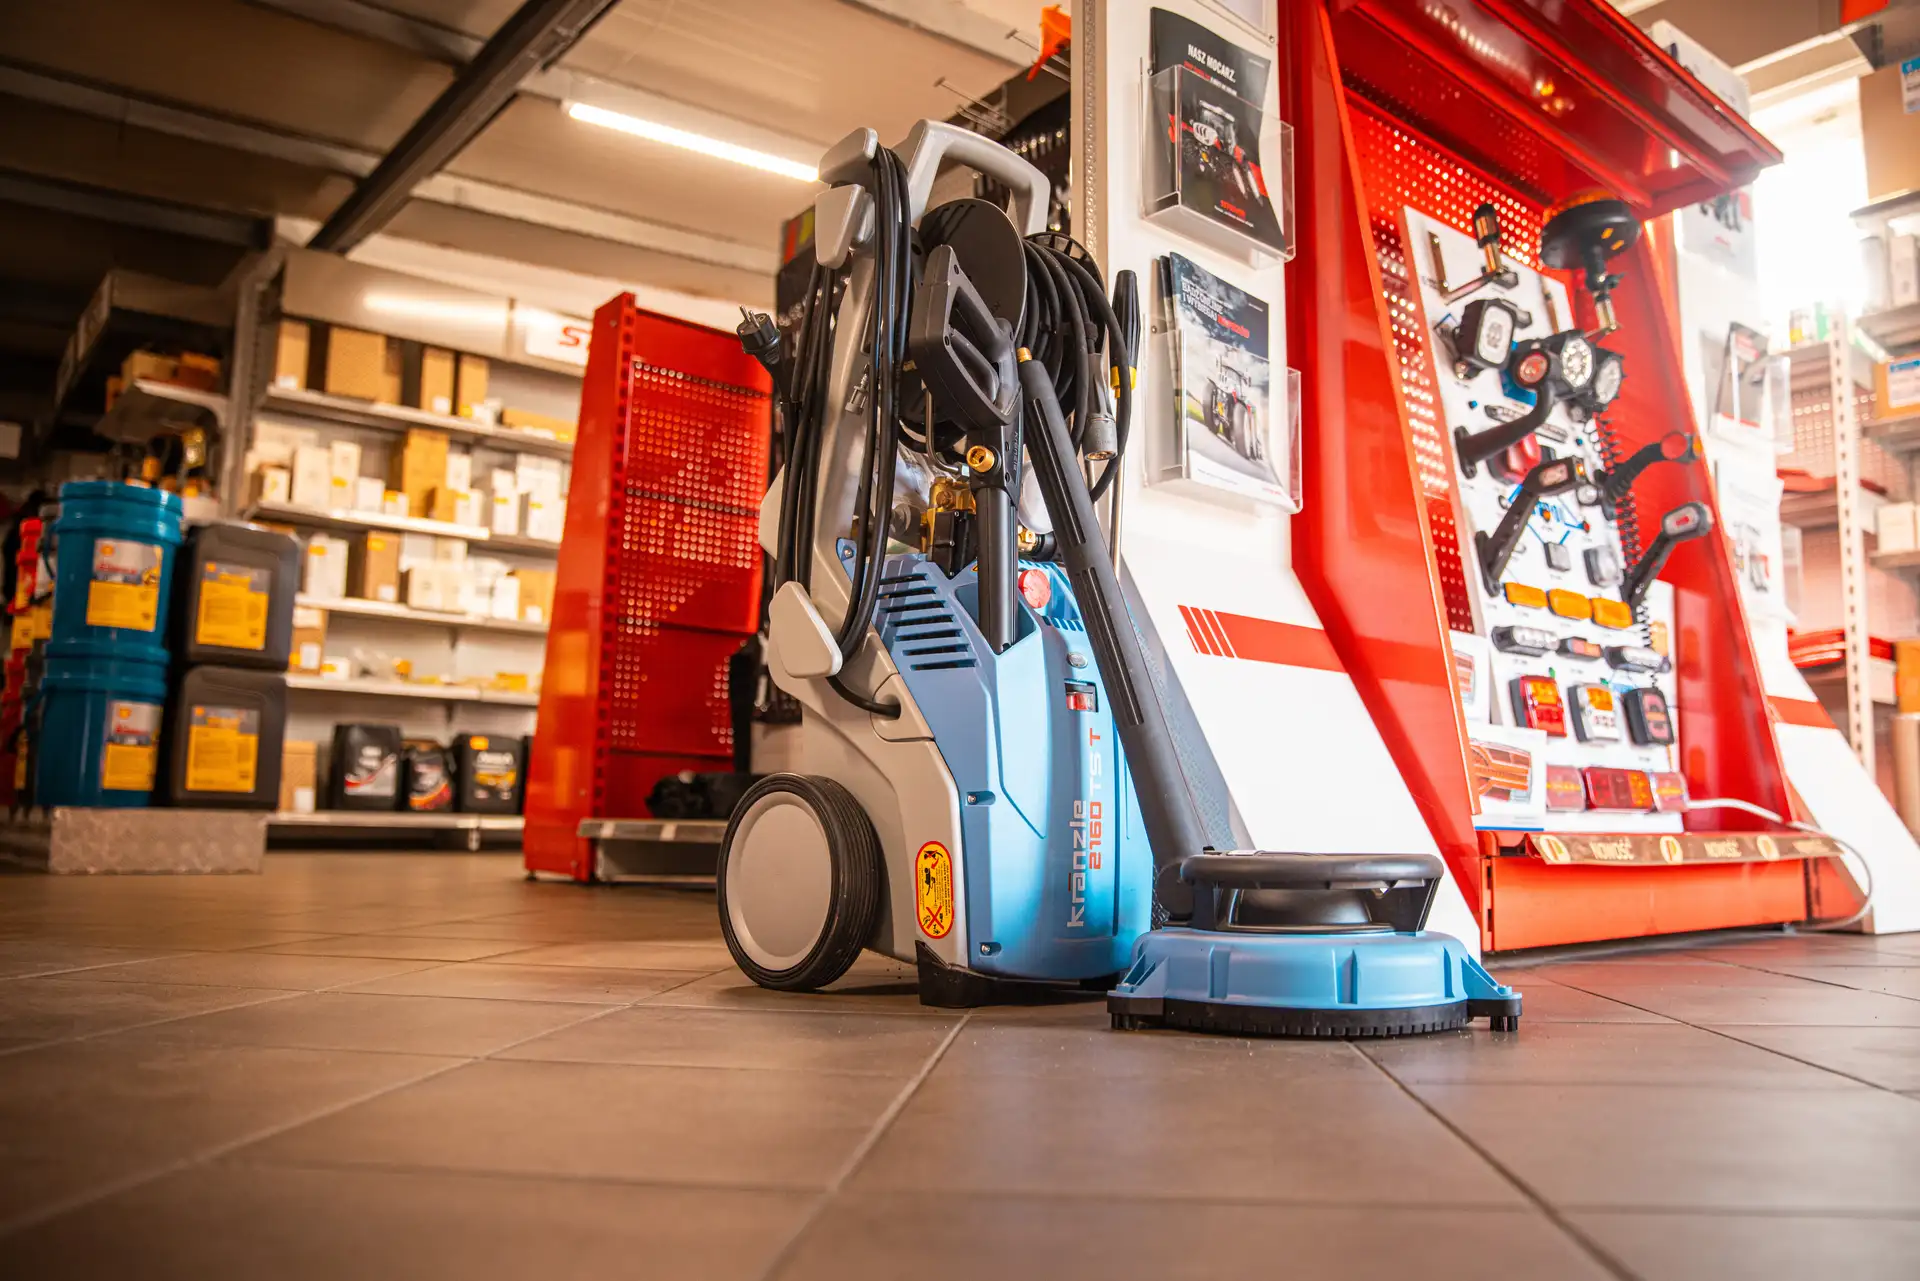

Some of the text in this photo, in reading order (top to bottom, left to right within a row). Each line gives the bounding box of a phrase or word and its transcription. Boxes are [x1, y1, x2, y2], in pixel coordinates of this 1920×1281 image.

[1188, 43, 1206, 65] NASZ
[1206, 55, 1236, 83] MOCARZ.
[1089, 727, 1101, 747] T
[1088, 801, 1102, 870] 2160
